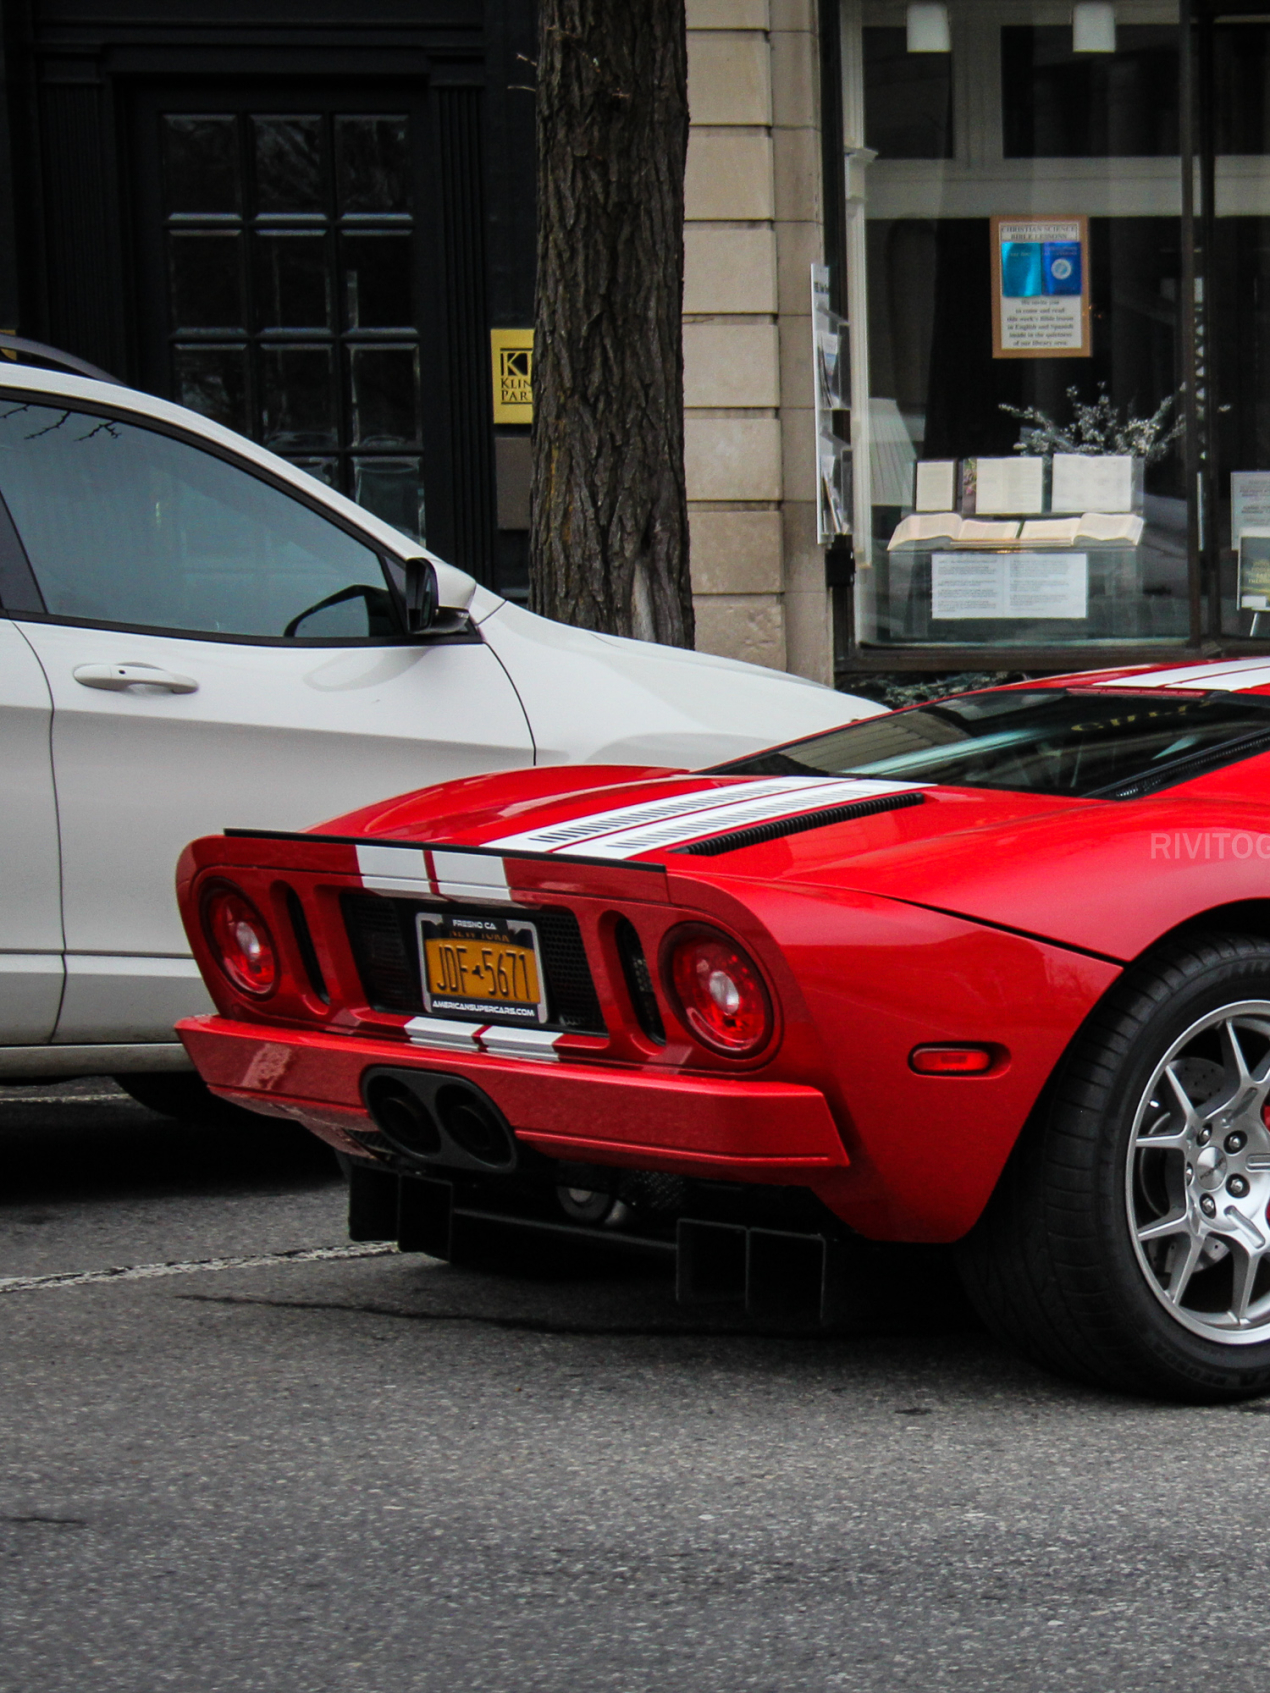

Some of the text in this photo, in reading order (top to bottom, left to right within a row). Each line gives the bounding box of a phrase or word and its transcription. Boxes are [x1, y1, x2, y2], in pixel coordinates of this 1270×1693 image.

[452, 919, 497, 930] FRESNO CA
[432, 1000, 535, 1017] AMERICANSUPERCARS.COM
